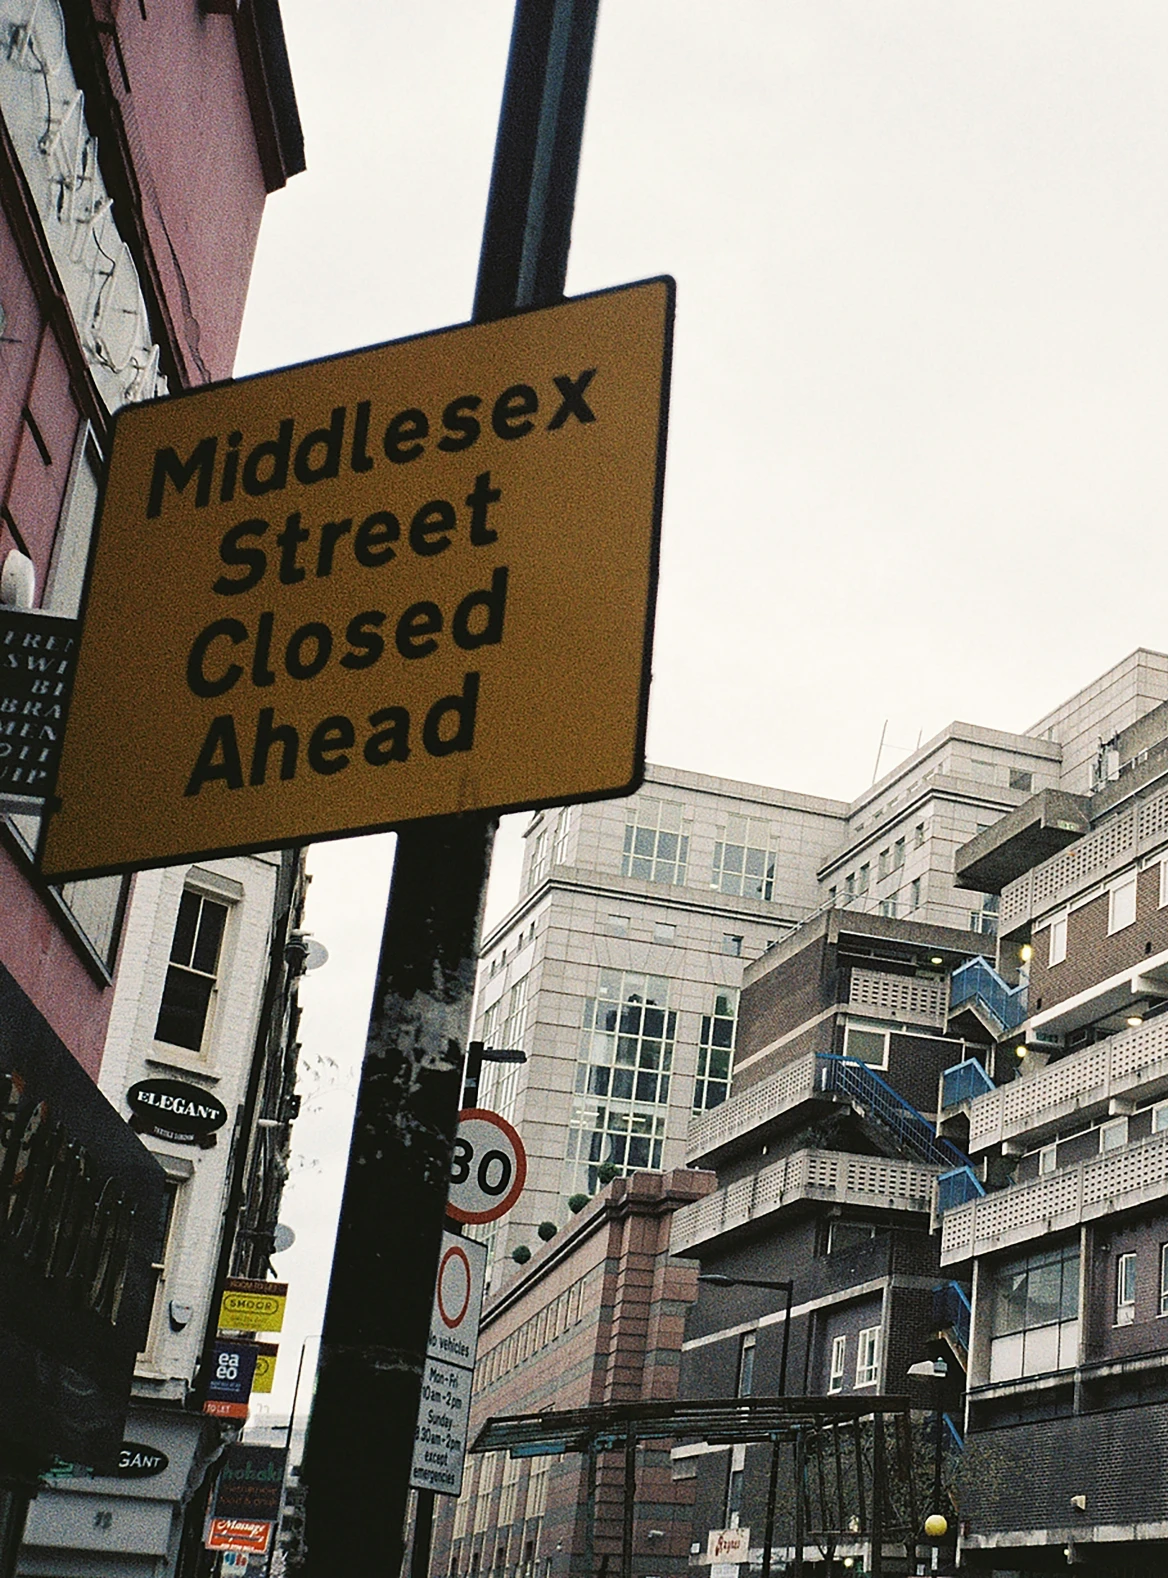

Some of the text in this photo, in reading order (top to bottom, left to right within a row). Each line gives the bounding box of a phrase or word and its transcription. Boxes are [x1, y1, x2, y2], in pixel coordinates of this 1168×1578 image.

[147, 367, 598, 520] Middlesex
[211, 471, 503, 597] Street
[185, 566, 509, 699] Closed
[183, 672, 480, 797] Ahead
[137, 1091, 220, 1120] ELEGANT
[449, 1137, 512, 1196] 30
[218, 1352, 239, 1366] ea
[439, 1336, 469, 1358] vehicles
[216, 1366, 238, 1380] eo
[428, 1409, 453, 1431] Sunday
[424, 1451, 448, 1467] except
[413, 1467, 455, 1485] emergencies
